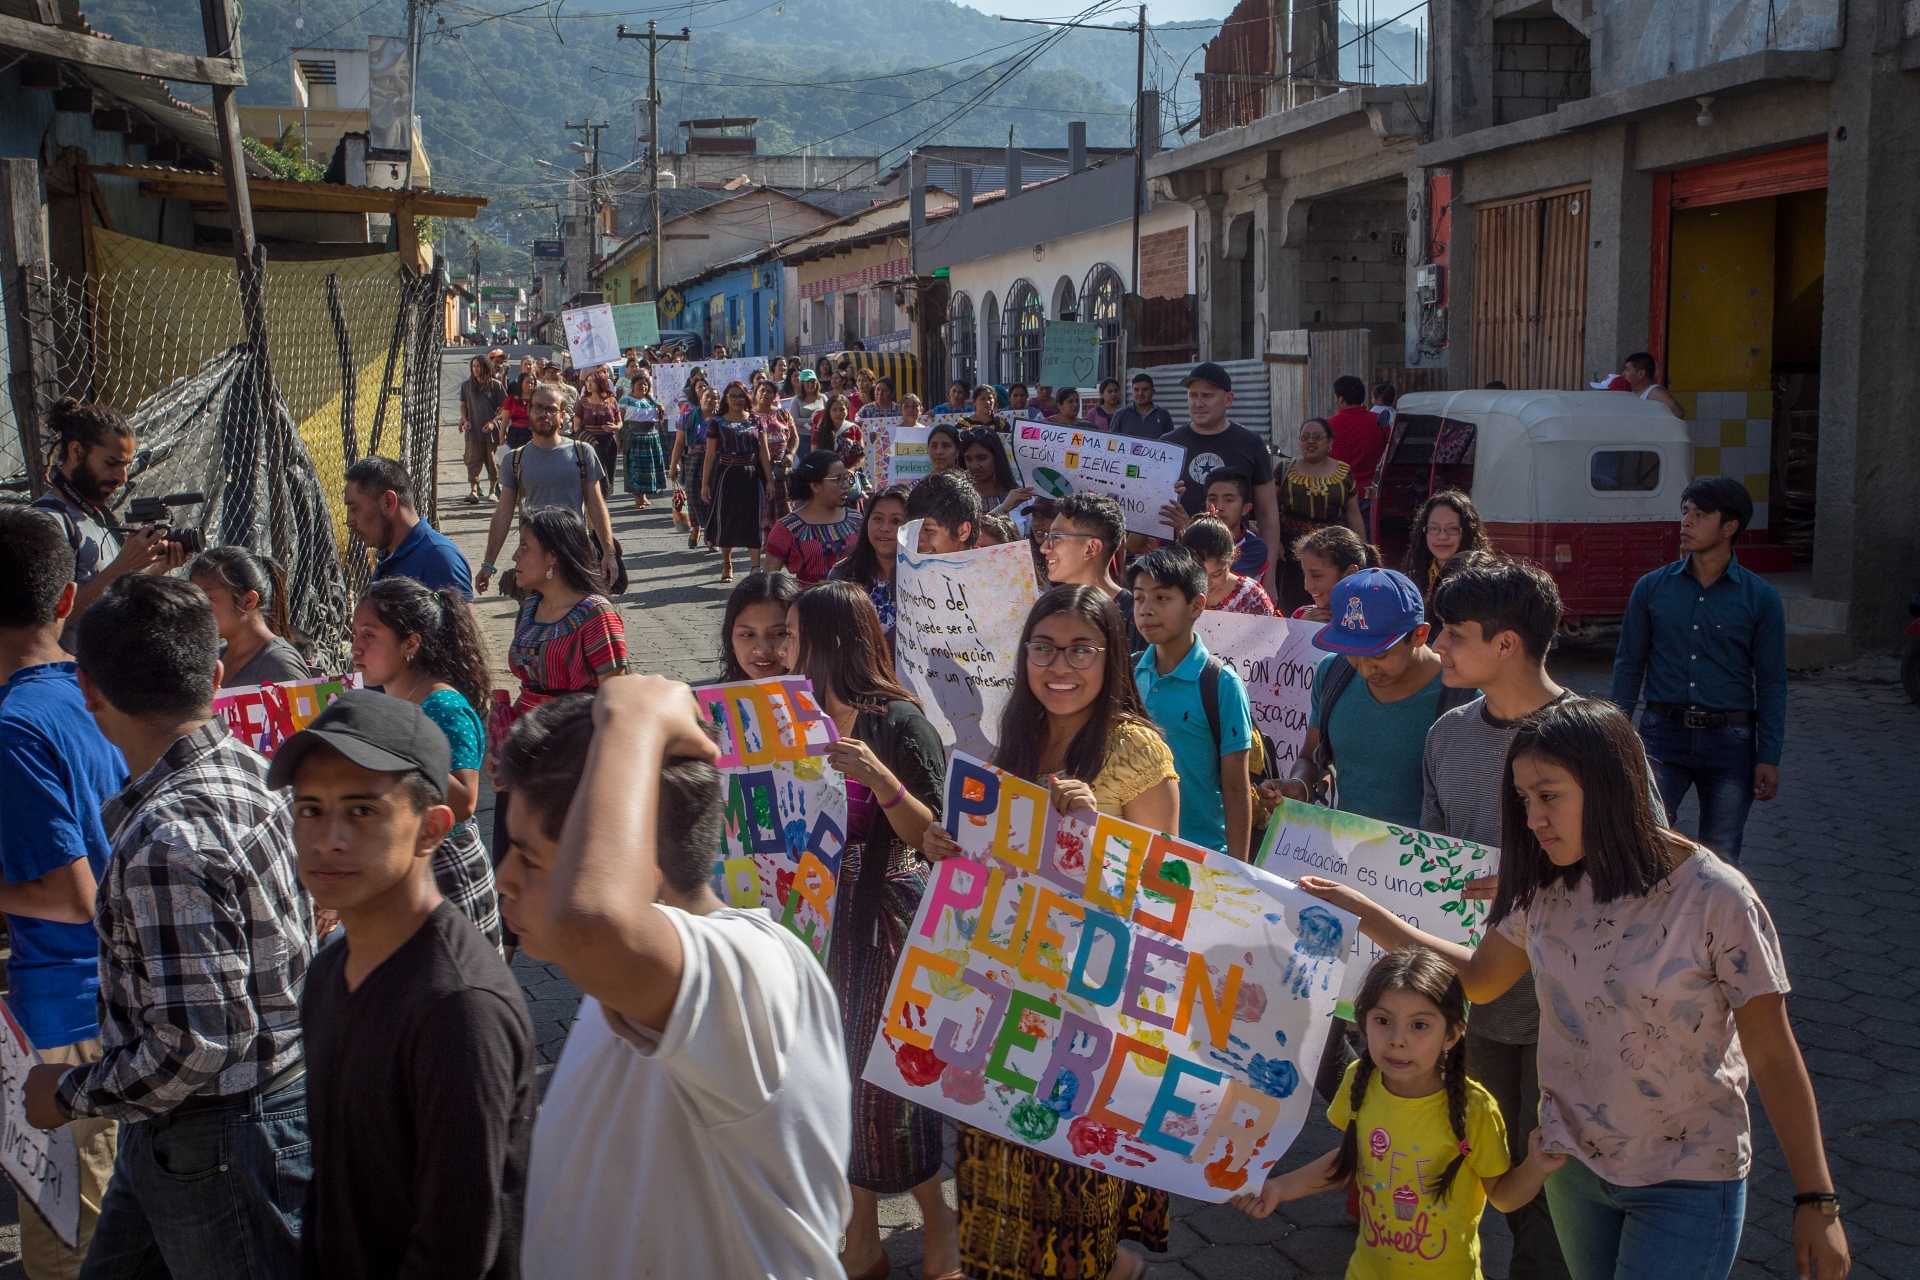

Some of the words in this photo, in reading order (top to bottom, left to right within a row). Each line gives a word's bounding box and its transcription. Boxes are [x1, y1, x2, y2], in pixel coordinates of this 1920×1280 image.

[1018, 445, 1055, 463] CIÓN
[1067, 452, 1120, 475] TIENE
[1127, 465, 1147, 480] EL
[1021, 427, 1040, 440] EL
[1040, 429, 1068, 443] QUE
[1071, 433, 1101, 449] AMA
[1107, 440, 1126, 453] LA
[1132, 444, 1174, 464] EDUCA-
[946, 581, 968, 611] del
[915, 615, 944, 635] puede
[946, 624, 962, 635] ser
[967, 616, 978, 635] el
[945, 672, 960, 687] un
[1243, 659, 1269, 684] SON
[1276, 661, 1315, 691] COMO
[944, 757, 1207, 941] POCOS
[1274, 827, 1291, 858] La
[1293, 834, 1348, 876] educación
[1356, 865, 1378, 886] es
[1384, 873, 1423, 897] una
[918, 856, 1244, 1051] PUEDEN
[885, 946, 1280, 1174] EJERCER
[1361, 1184, 1447, 1261] Sweet
